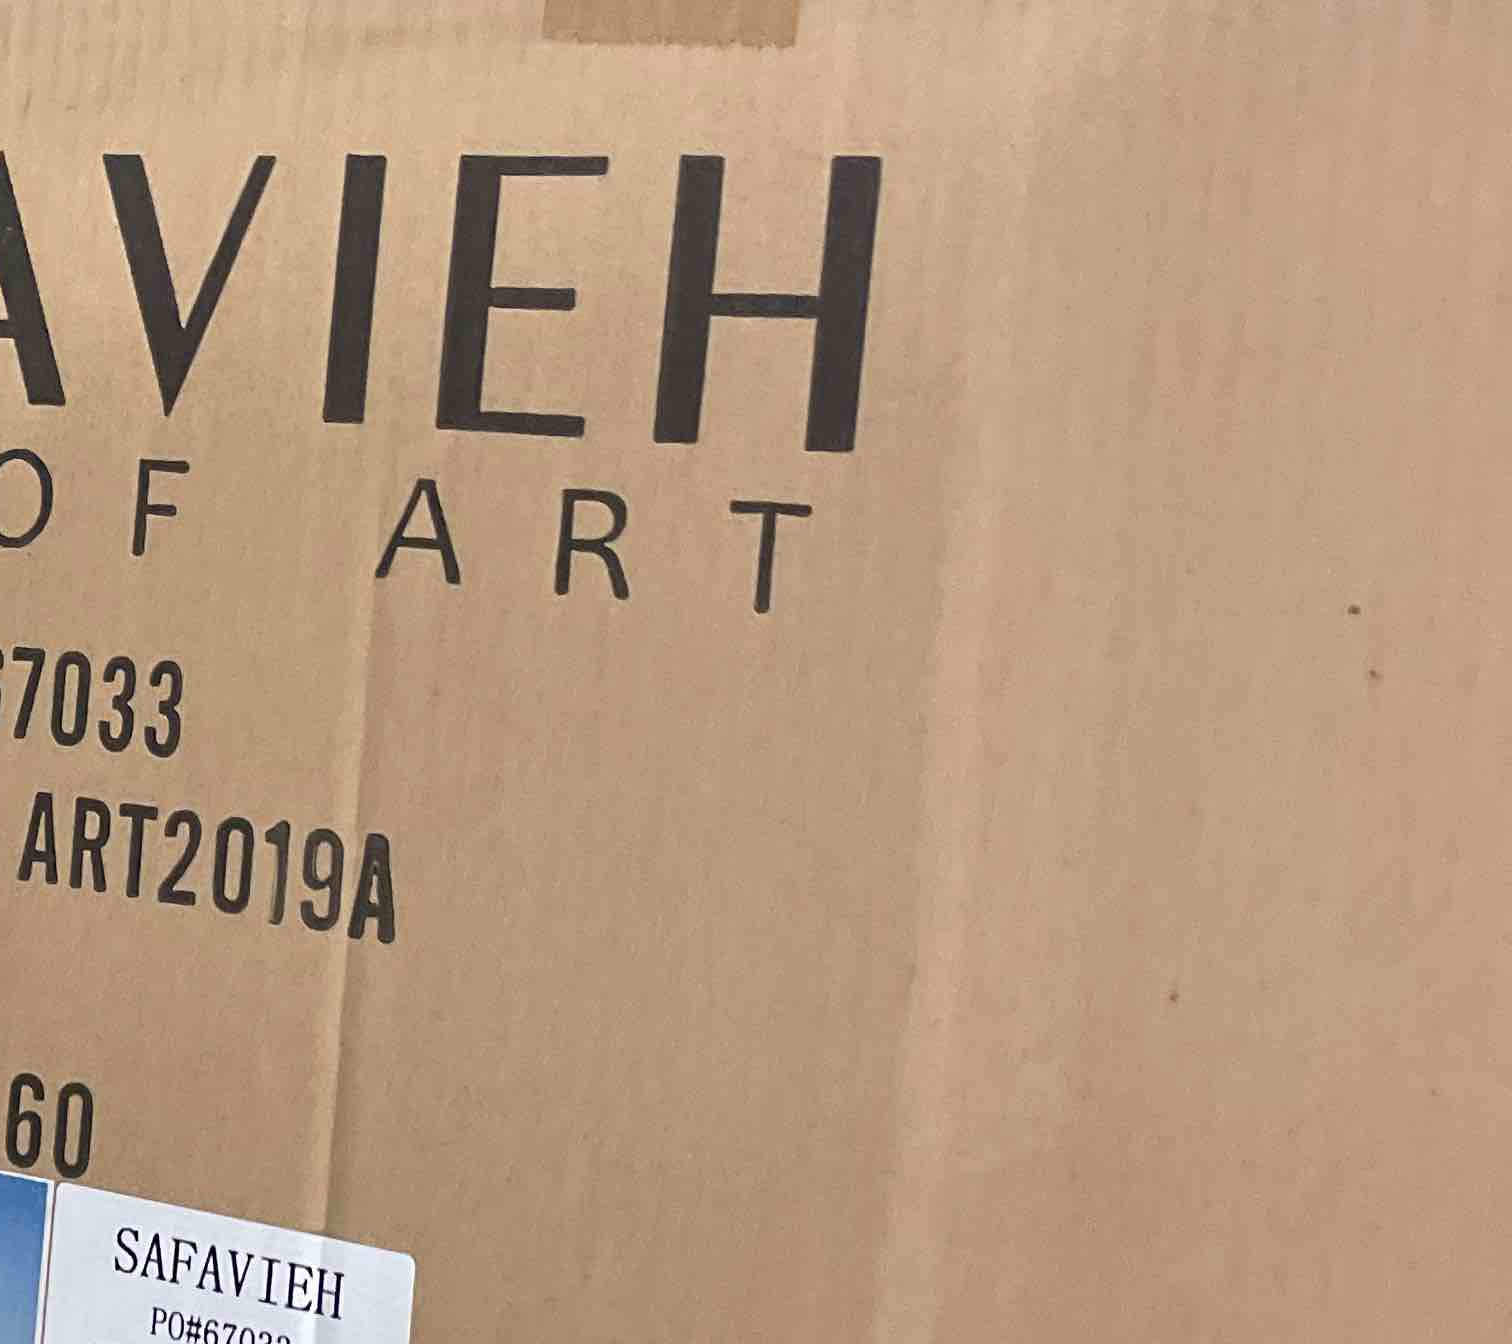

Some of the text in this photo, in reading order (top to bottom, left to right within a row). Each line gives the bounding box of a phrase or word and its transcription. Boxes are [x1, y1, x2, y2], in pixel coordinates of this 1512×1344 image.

[375, 475, 814, 616] ART
[17, 789, 396, 945] ART2019A
[4, 1071, 94, 1180] 60
[114, 1226, 344, 1320] SAFAVIEH
